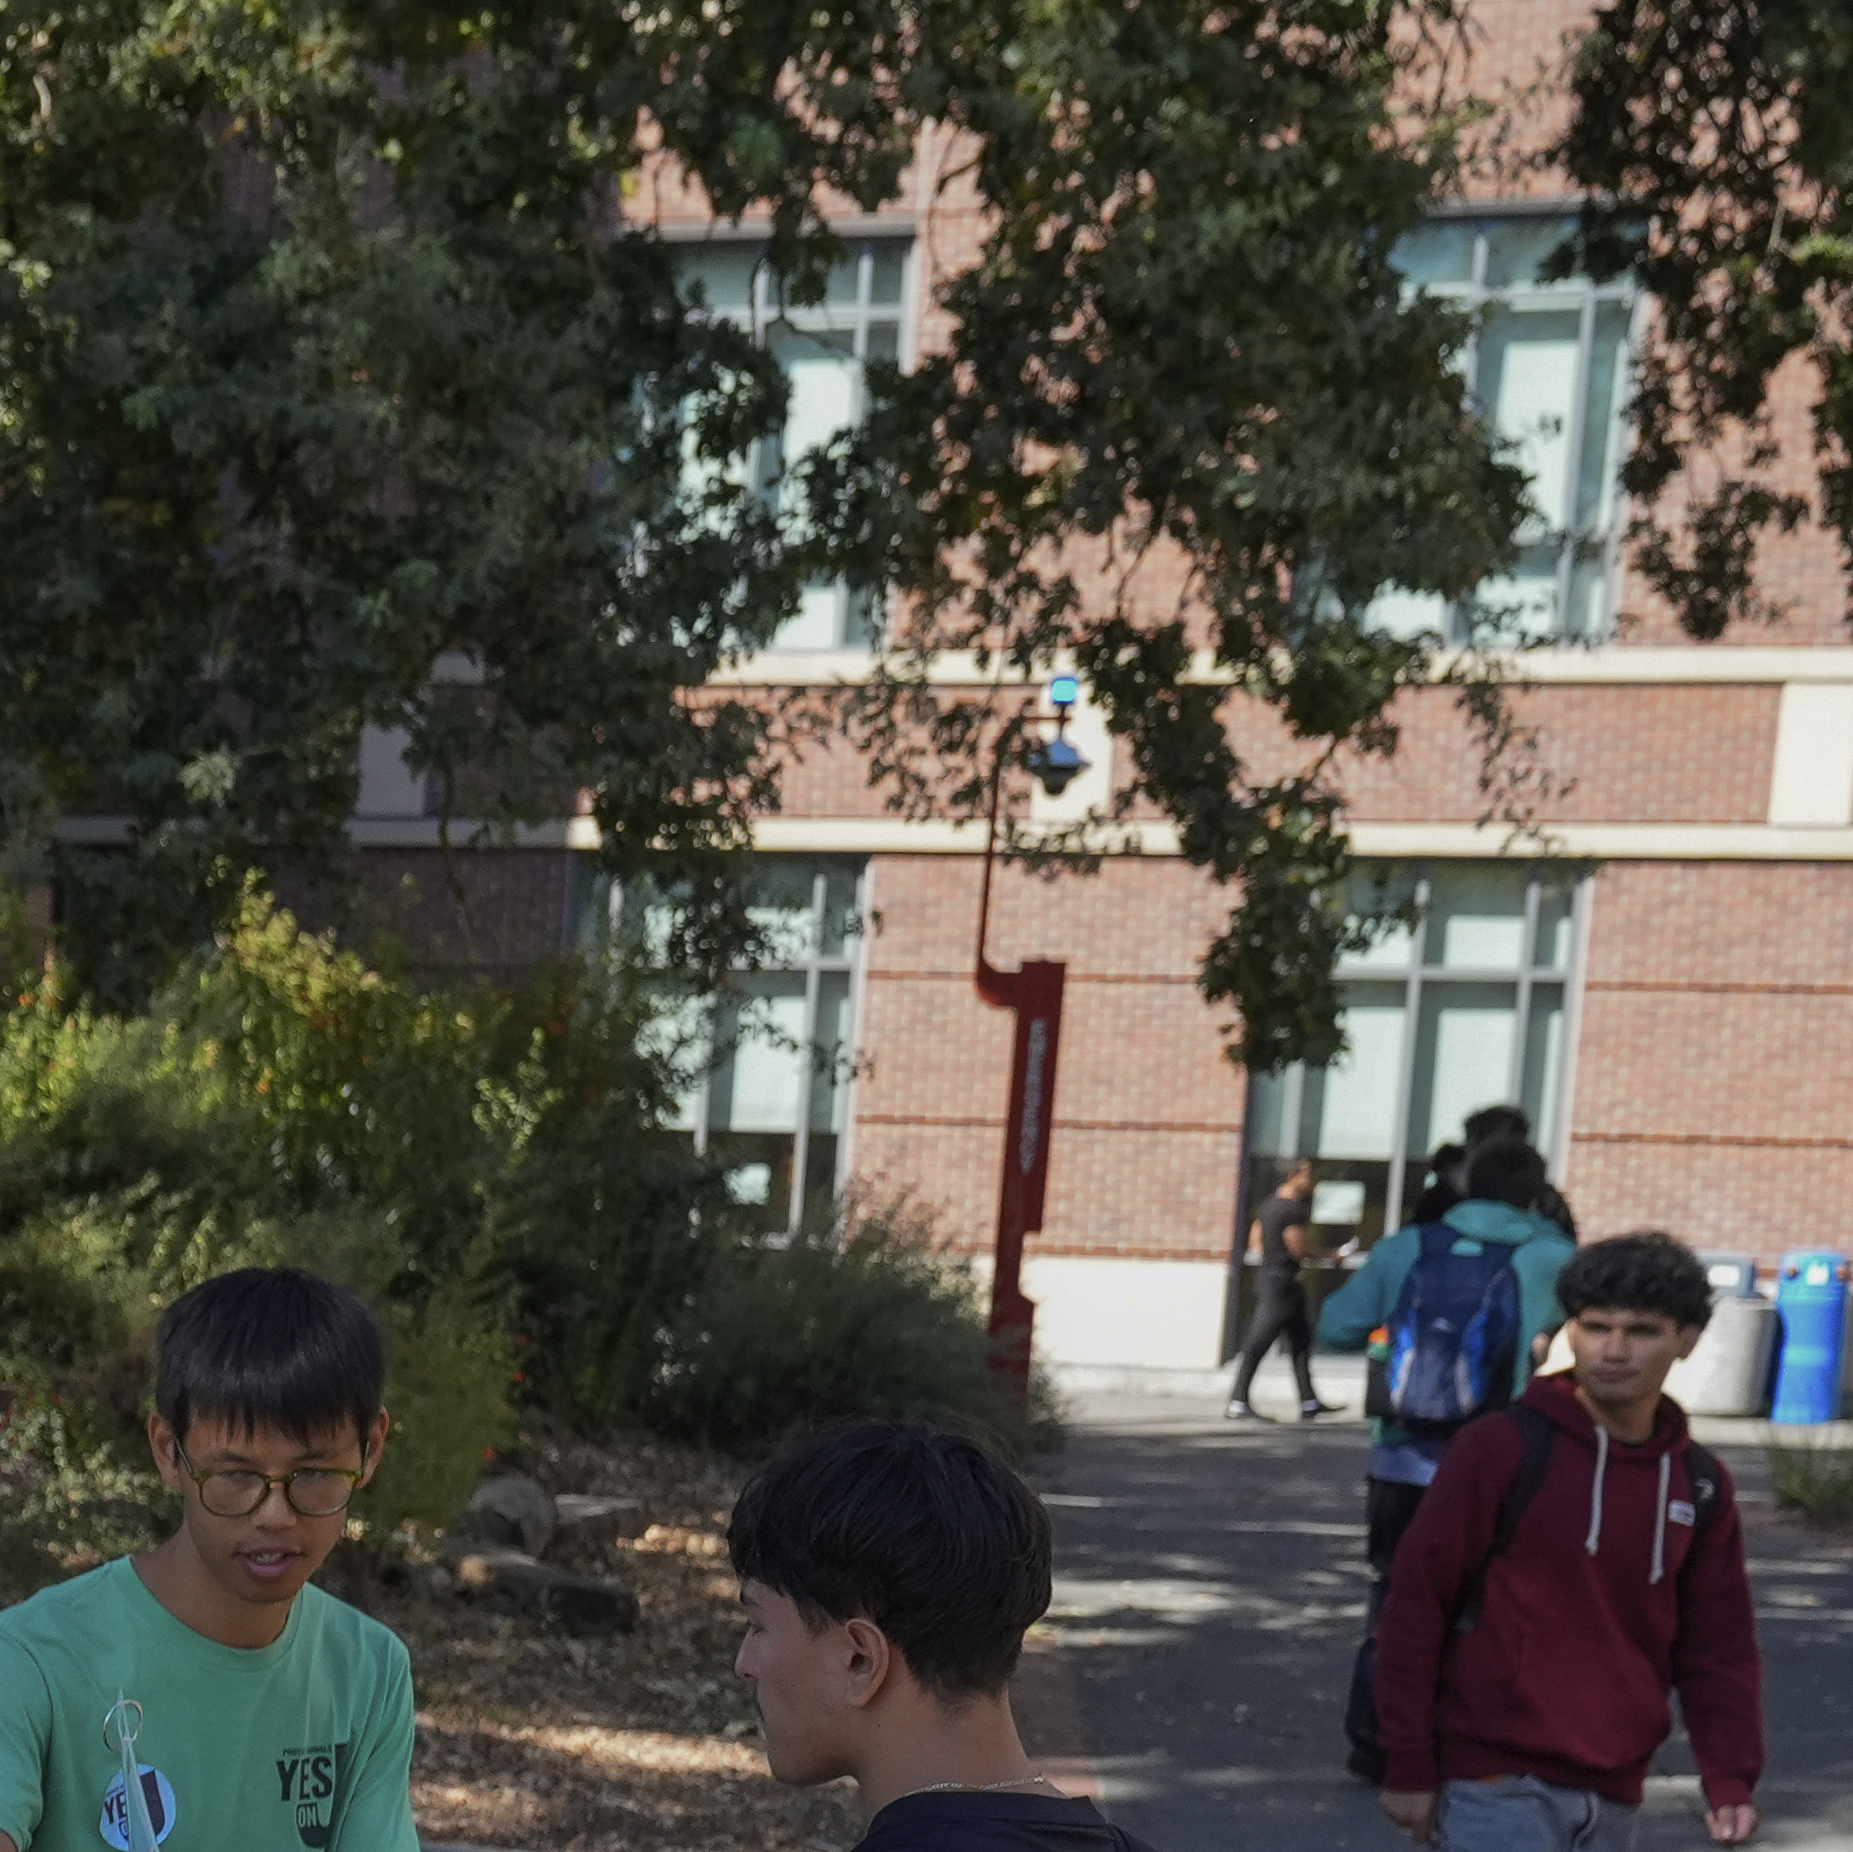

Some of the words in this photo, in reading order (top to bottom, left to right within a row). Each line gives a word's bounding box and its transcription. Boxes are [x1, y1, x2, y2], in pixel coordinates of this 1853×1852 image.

[276, 1756, 333, 1802] YES
[104, 1790, 128, 1825] YE
[297, 1805, 317, 1829] ON
